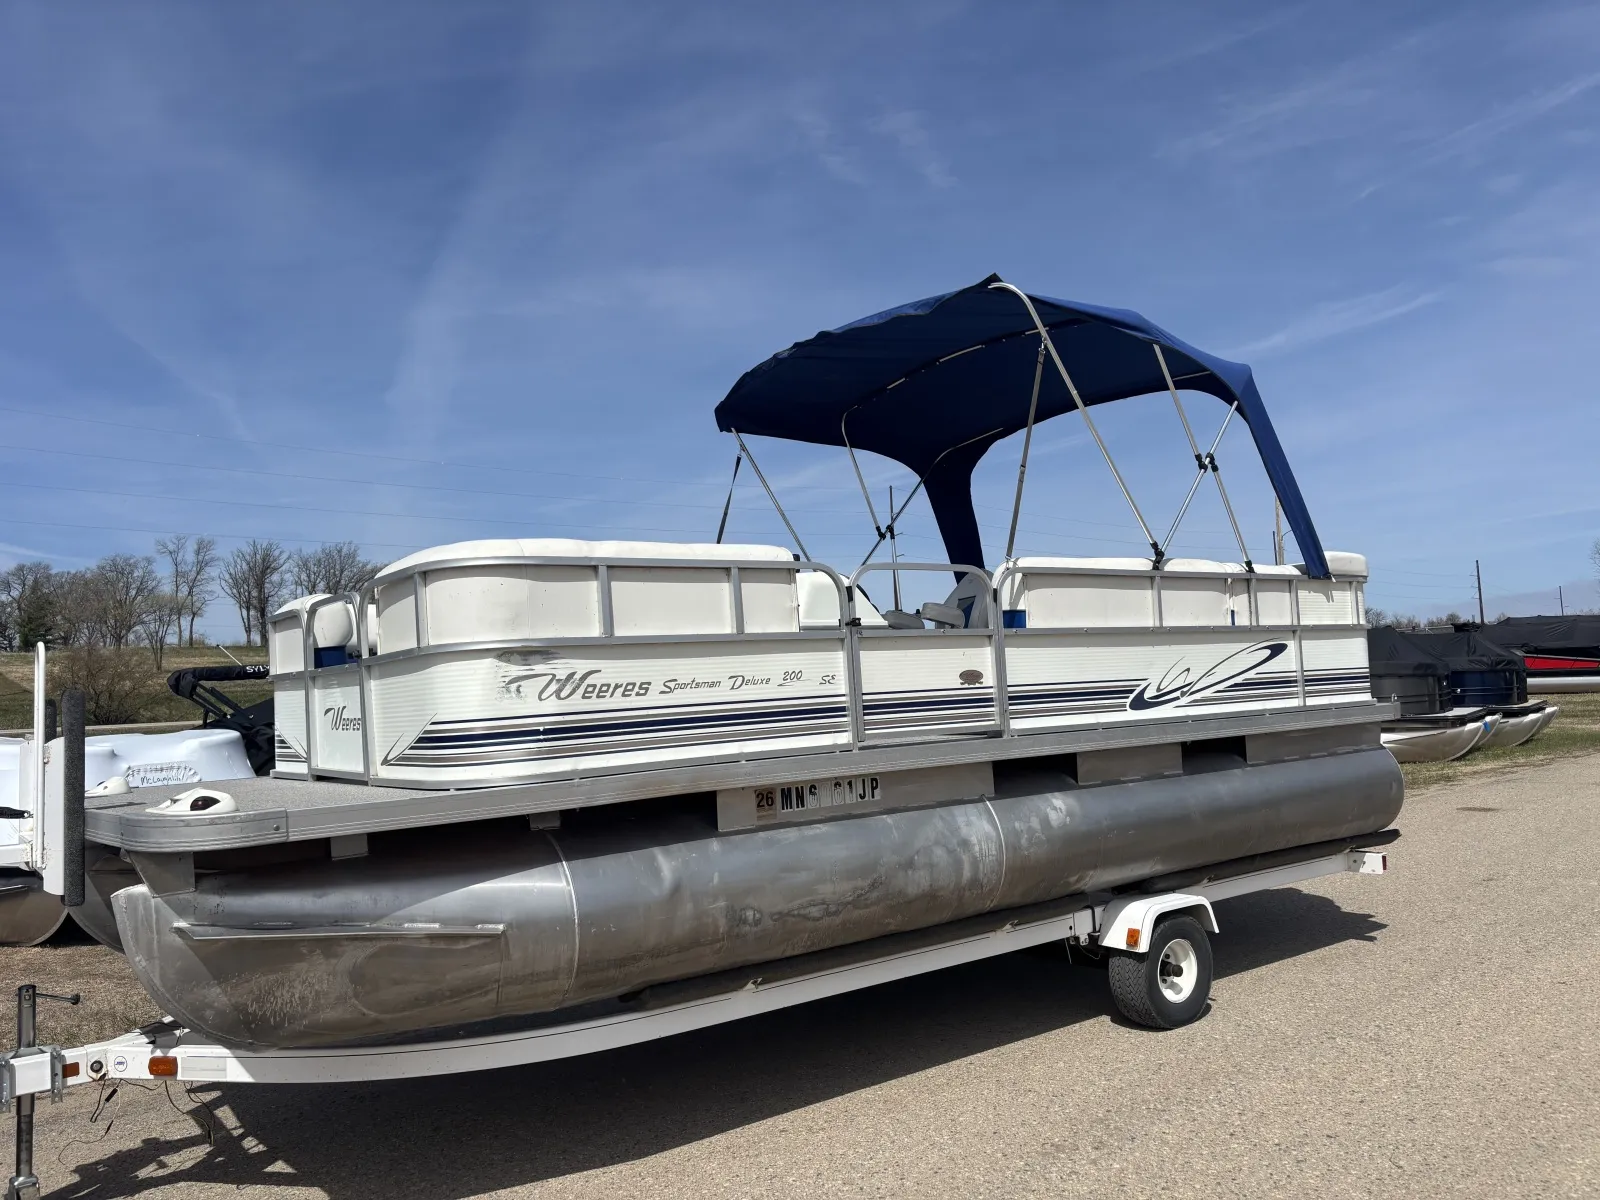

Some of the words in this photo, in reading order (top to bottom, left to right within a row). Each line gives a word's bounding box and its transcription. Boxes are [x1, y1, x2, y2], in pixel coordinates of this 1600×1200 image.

[505, 669, 652, 702] Weeres
[658, 678, 722, 694] Sportsman
[727, 675, 771, 690] Deluxe
[782, 670, 803, 682] 200
[323, 705, 361, 731] Weeres
[756, 791, 774, 808] 26
